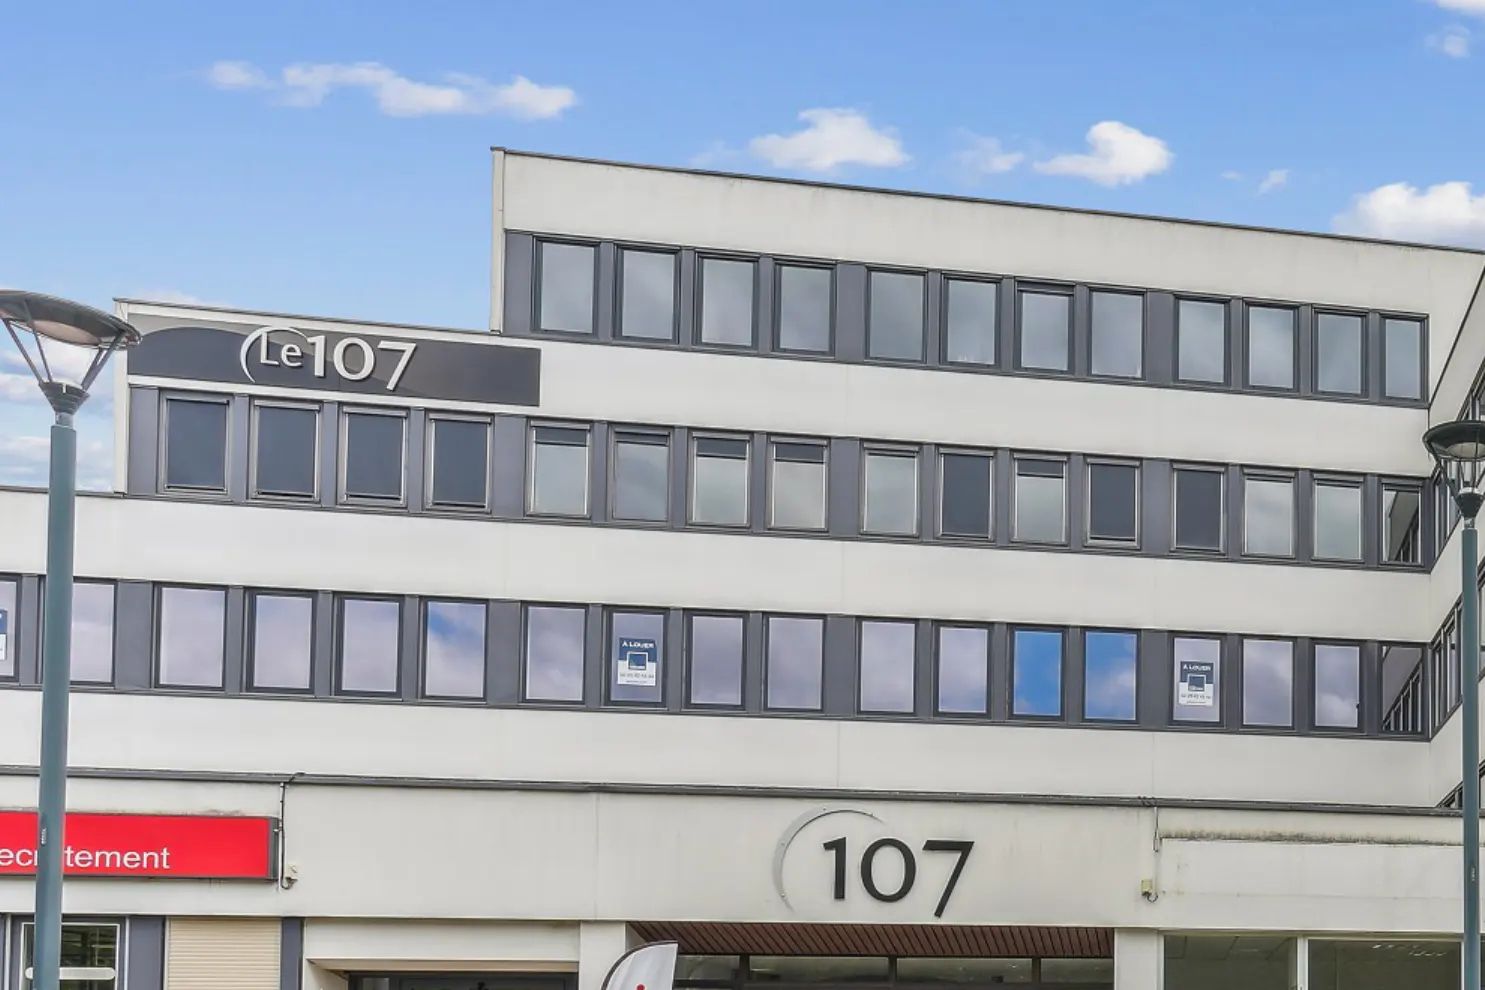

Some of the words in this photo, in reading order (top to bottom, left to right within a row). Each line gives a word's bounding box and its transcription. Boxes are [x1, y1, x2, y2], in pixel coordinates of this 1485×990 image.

[260, 331, 303, 367] Le
[307, 335, 417, 391] 107
[822, 837, 975, 919] 107
